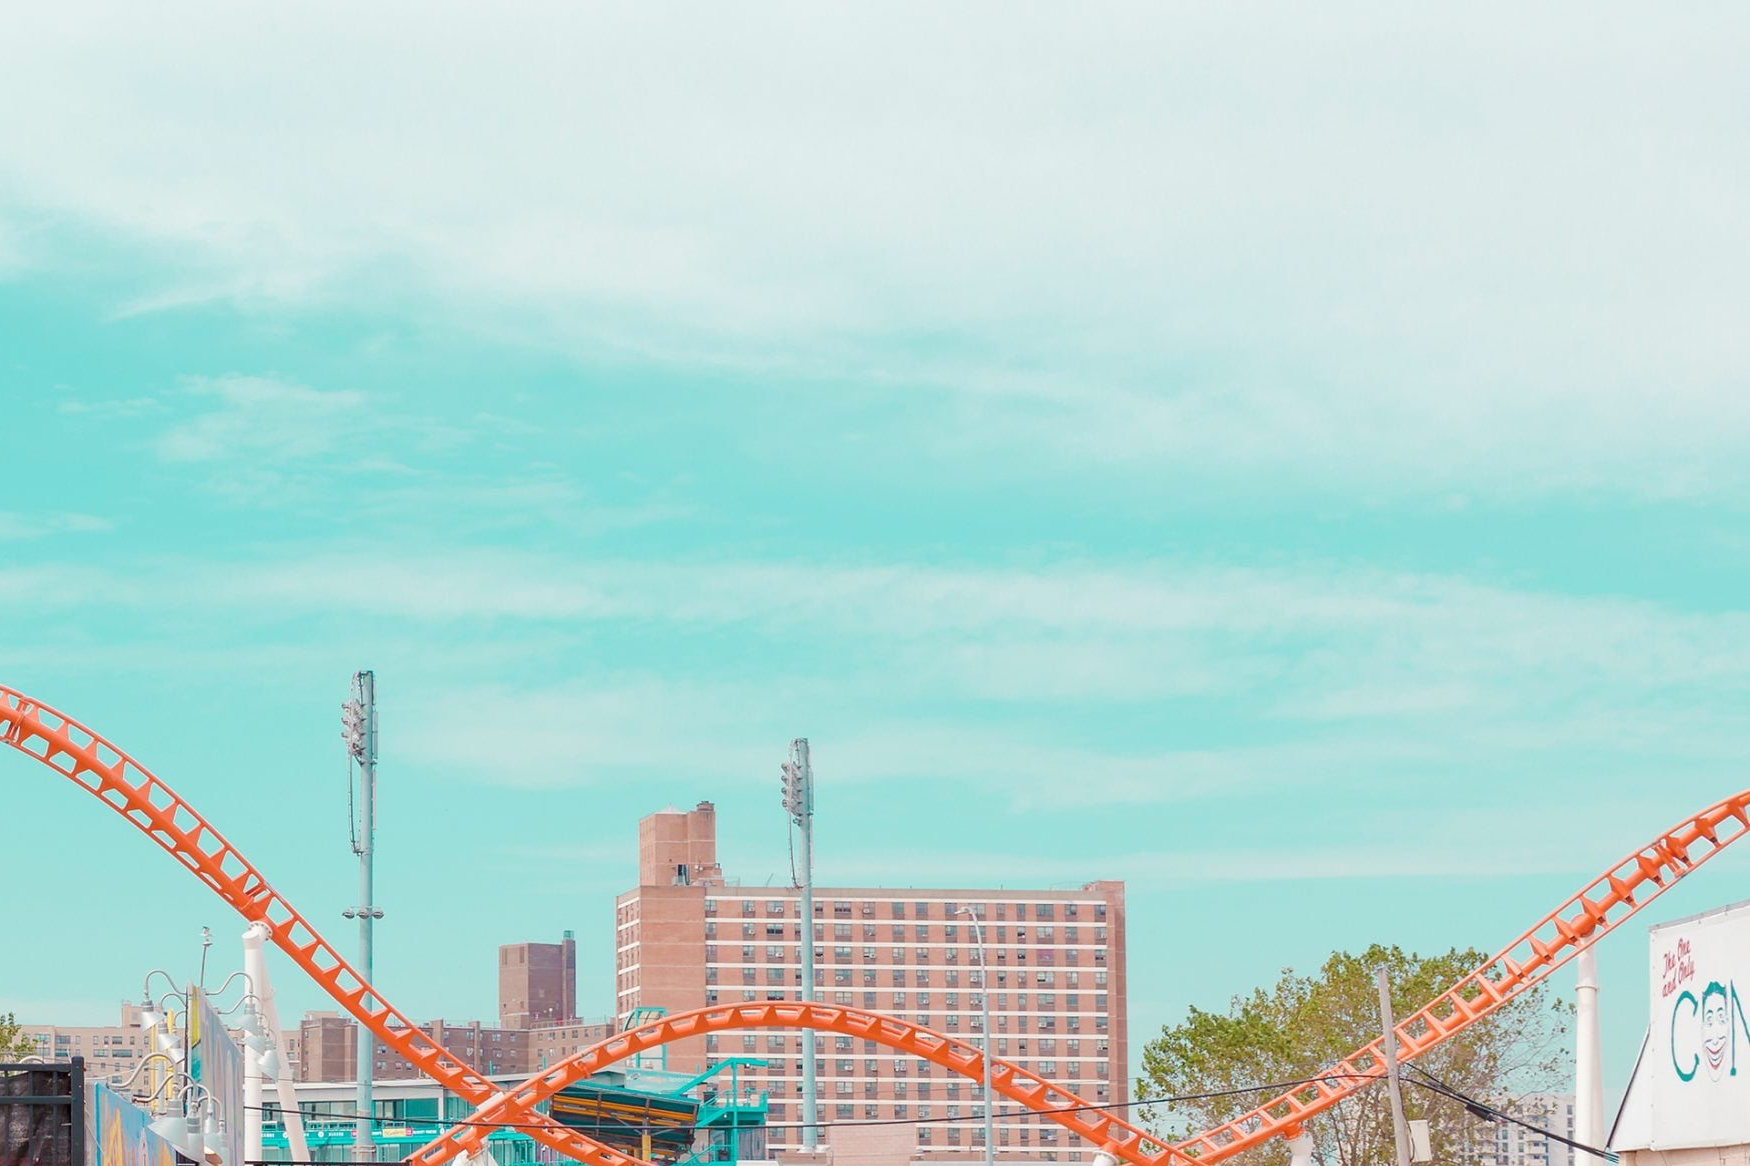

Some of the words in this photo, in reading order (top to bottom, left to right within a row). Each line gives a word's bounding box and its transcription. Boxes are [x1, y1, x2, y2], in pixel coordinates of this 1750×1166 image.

[1662, 952, 1676, 979] The
[1677, 938, 1691, 961] One
[1662, 969, 1677, 998] and
[1678, 955, 1695, 984] Only
